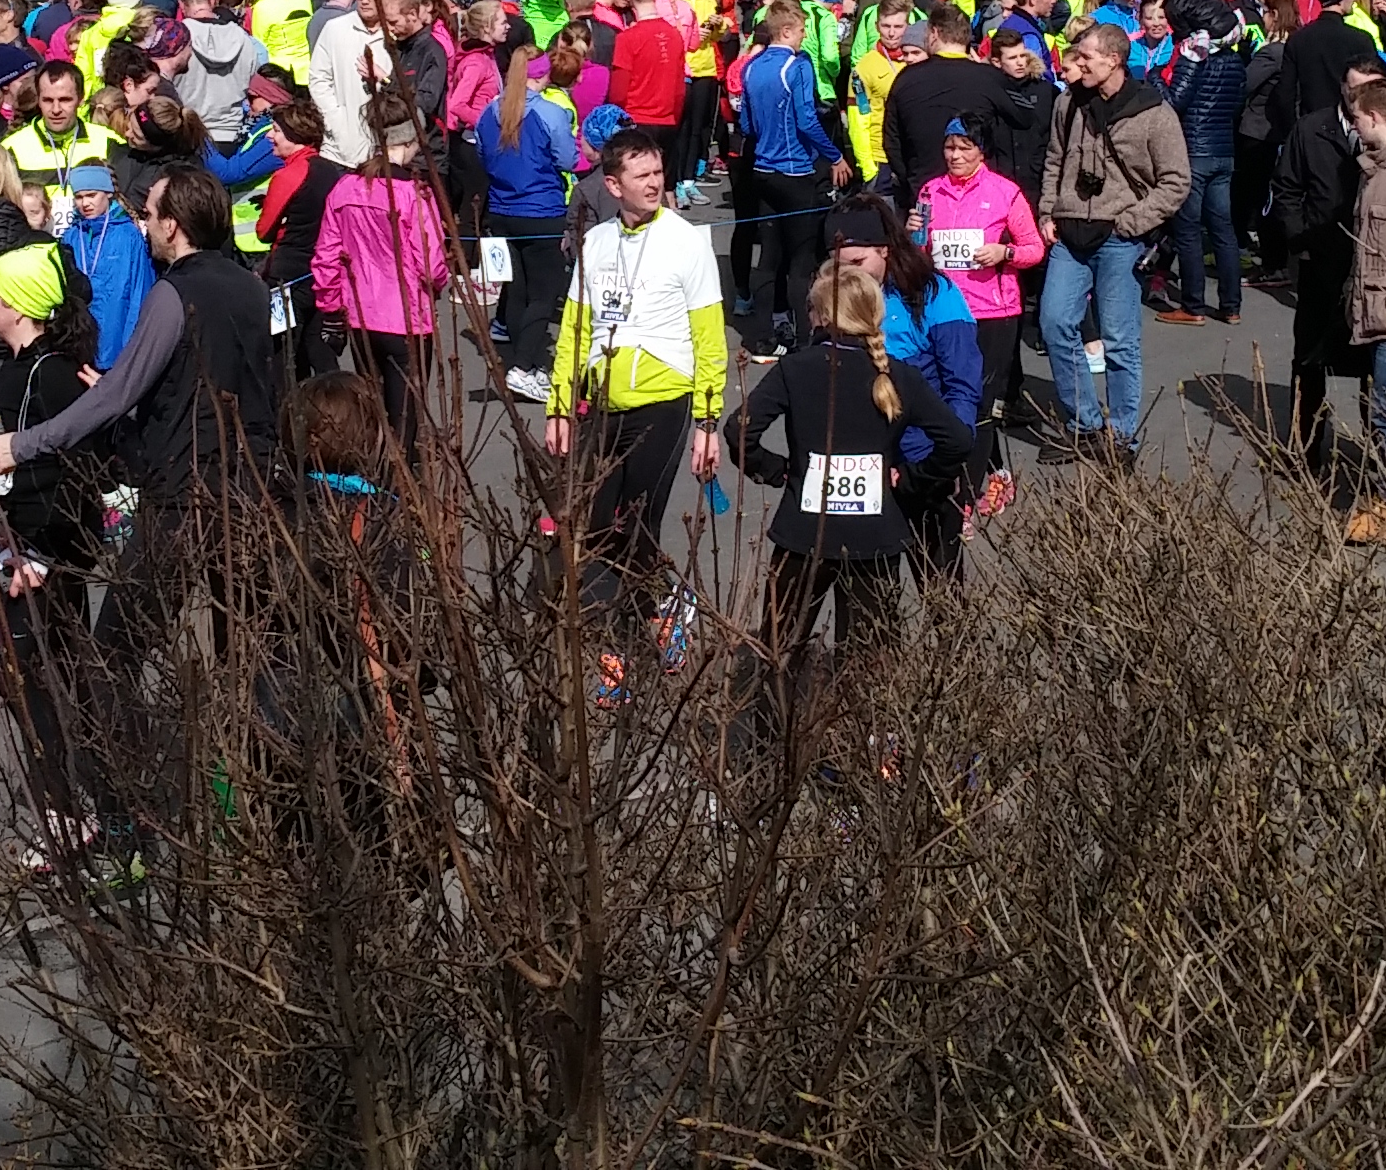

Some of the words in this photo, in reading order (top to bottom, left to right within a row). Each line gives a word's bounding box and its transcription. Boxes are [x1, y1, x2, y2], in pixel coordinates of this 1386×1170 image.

[941, 243, 971, 259] 876
[824, 475, 867, 498] 586
[827, 502, 860, 511] NIVEA
